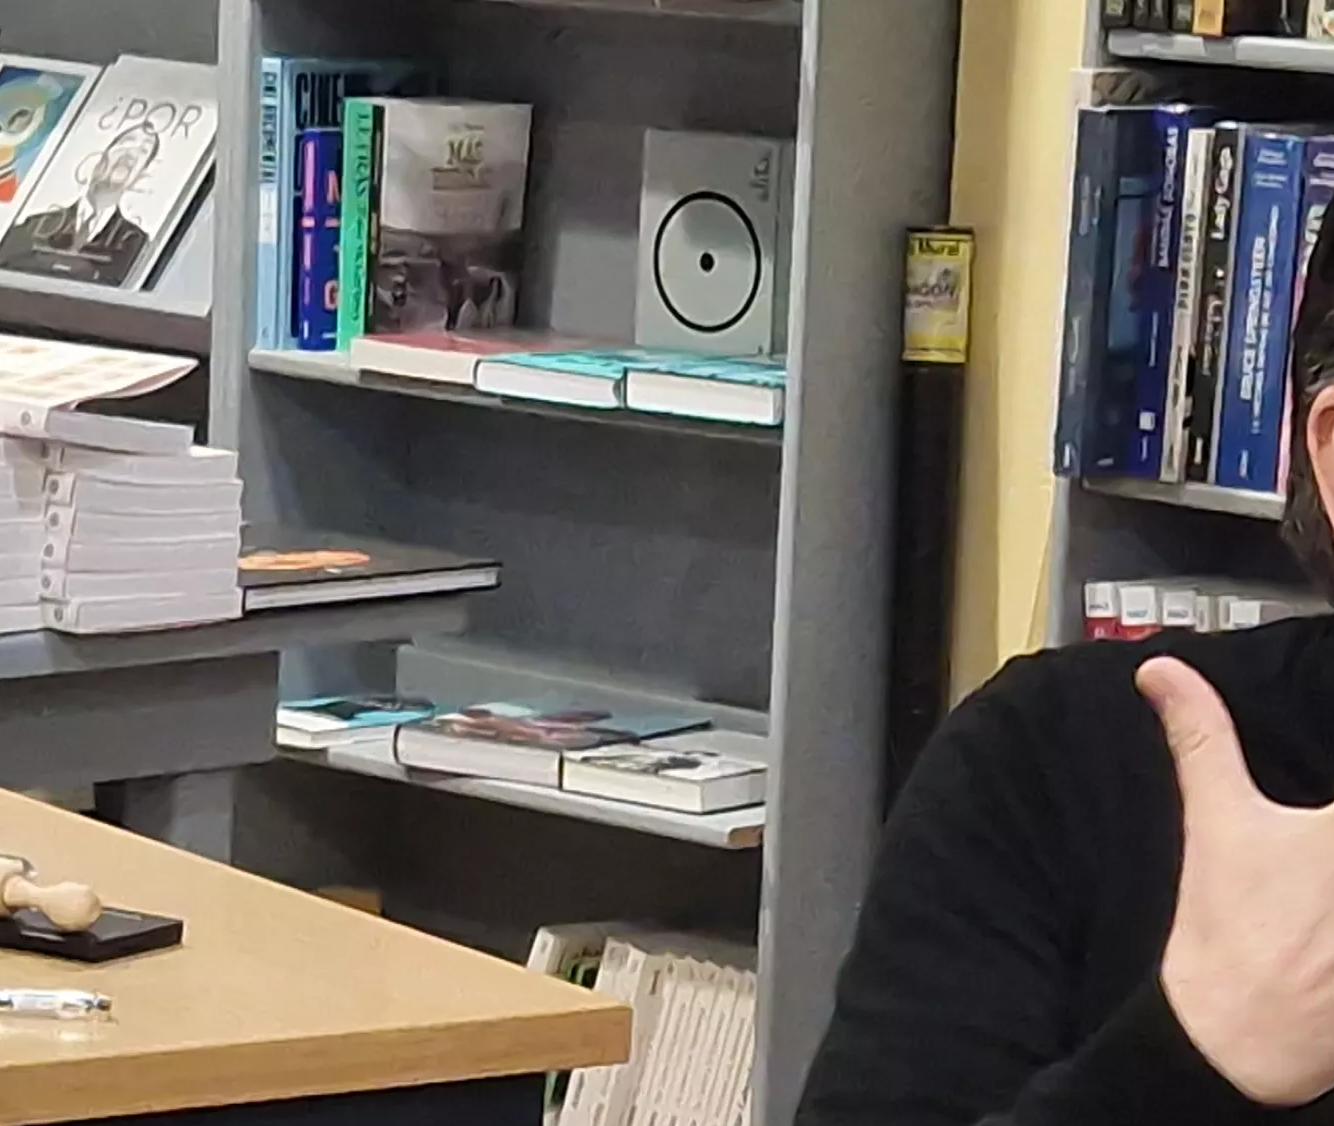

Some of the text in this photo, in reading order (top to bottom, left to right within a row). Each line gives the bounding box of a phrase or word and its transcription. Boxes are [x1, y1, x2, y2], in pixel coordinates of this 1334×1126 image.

[1213, 145, 1235, 194] Gaga
[1210, 195, 1232, 241] Lady
[1244, 235, 1266, 344] SPRINGSTEEN
[1240, 348, 1256, 400] BRUCE
